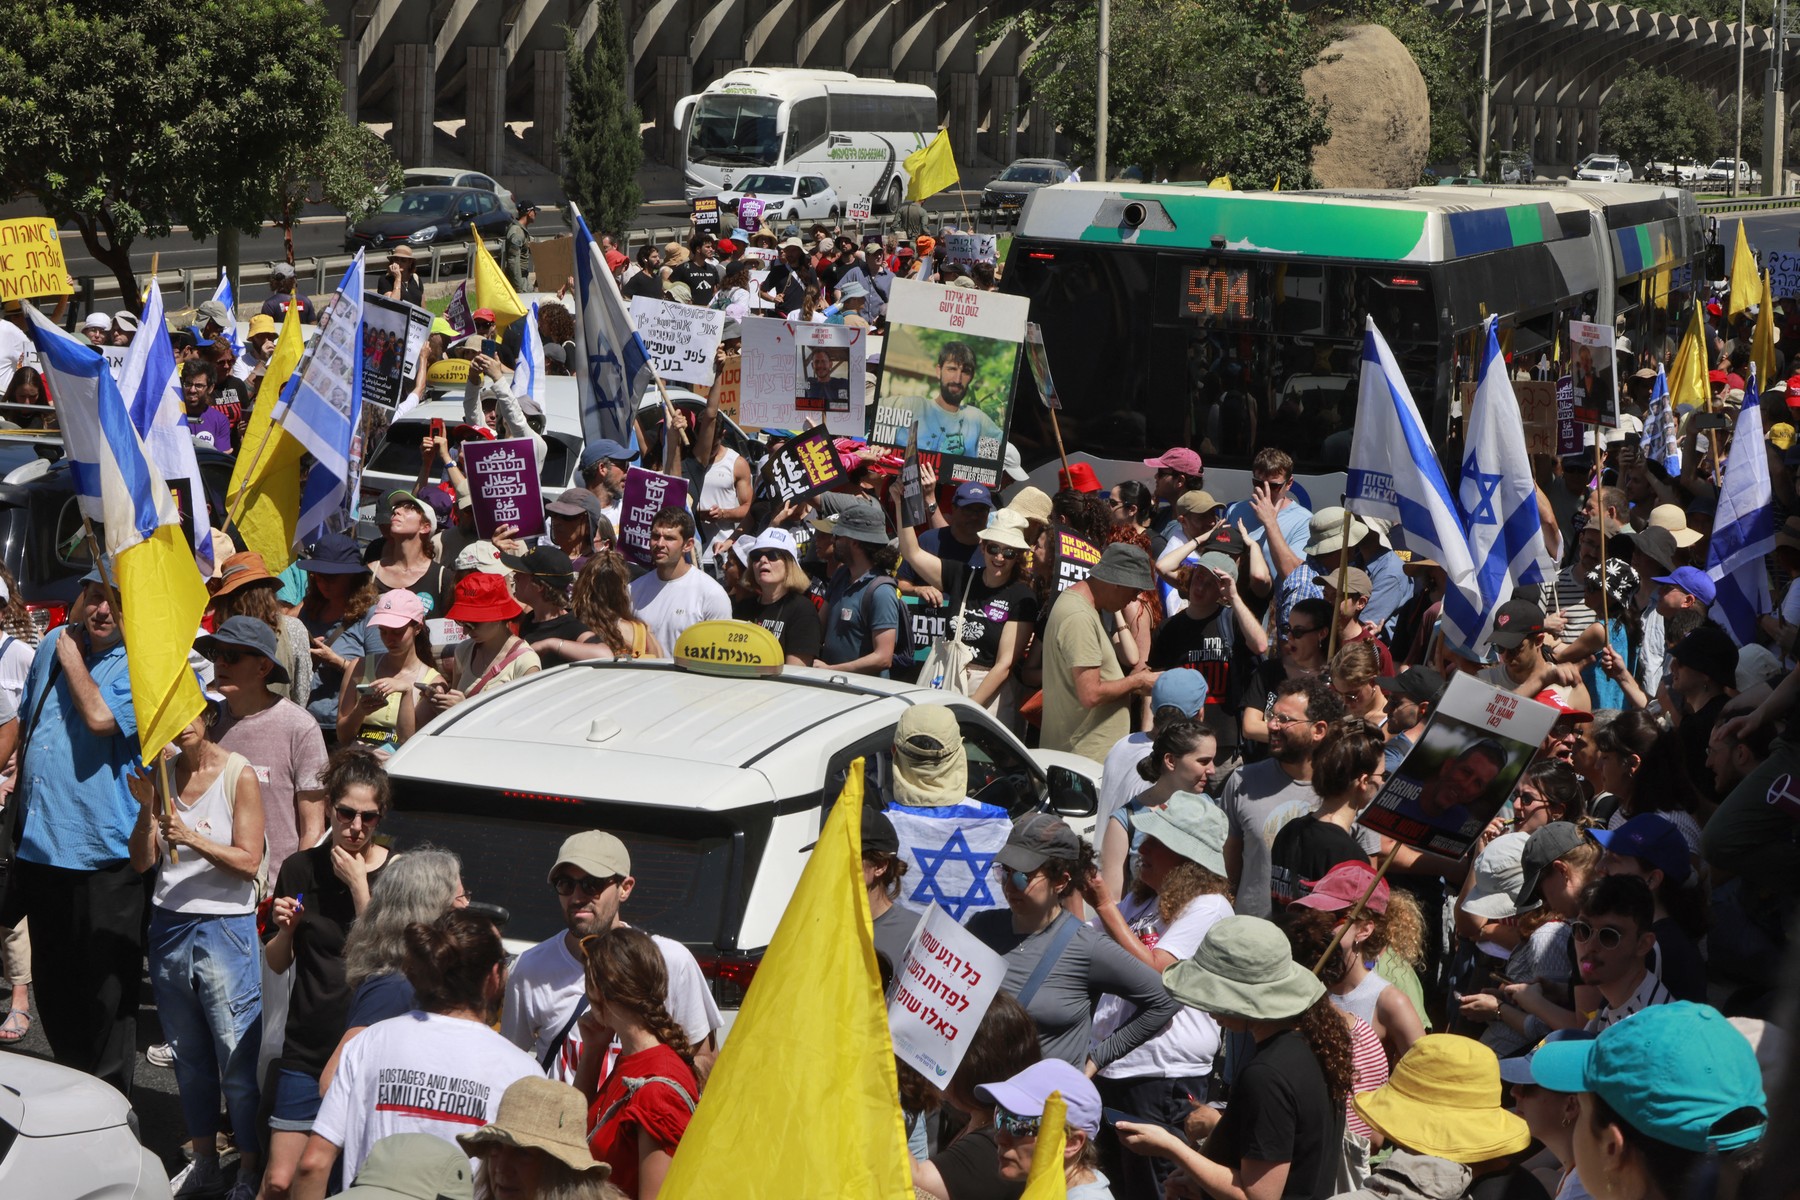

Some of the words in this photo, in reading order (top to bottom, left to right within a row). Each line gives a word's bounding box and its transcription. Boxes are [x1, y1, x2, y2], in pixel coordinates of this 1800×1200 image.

[2, 223, 49, 247] אמהות
[944, 290, 964, 304] אילוז
[966, 294, 978, 305] גיא
[1188, 270, 1248, 315] 504
[939, 301, 954, 313] GUY
[955, 304, 980, 318] ILLOUZ
[949, 315, 966, 328] (26)
[650, 355, 684, 372] בעז
[682, 348, 706, 364] לפני
[876, 404, 913, 428] BRING
[872, 424, 898, 445] HIM
[482, 448, 516, 462] نرفض
[478, 461, 523, 472] מסרבים
[972, 466, 980, 474] AND
[980, 468, 998, 476] MISSING
[484, 472, 521, 488] احتلال
[952, 469, 976, 482] FAMILIES
[976, 473, 996, 485] FORUM
[484, 484, 523, 496] לכיבוש
[648, 488, 663, 499] עד
[496, 497, 515, 512] غزة
[496, 510, 518, 520] עזה
[632, 510, 653, 522] טוף
[1061, 534, 1076, 546] את
[728, 632, 749, 643] 2292
[684, 642, 716, 660] taxi
[717, 648, 762, 664] מונית
[1486, 702, 1498, 715] TAL
[1496, 706, 1515, 720] HAIMI
[1486, 714, 1502, 728] (42)
[1387, 777, 1423, 801] BRING
[1376, 791, 1403, 812] HIM
[380, 1068, 426, 1086] HOSTAGES
[426, 1074, 448, 1091] AND
[448, 1077, 491, 1101] MISSING
[378, 1084, 436, 1111] FAMILIES
[438, 1092, 488, 1121] FORUM
